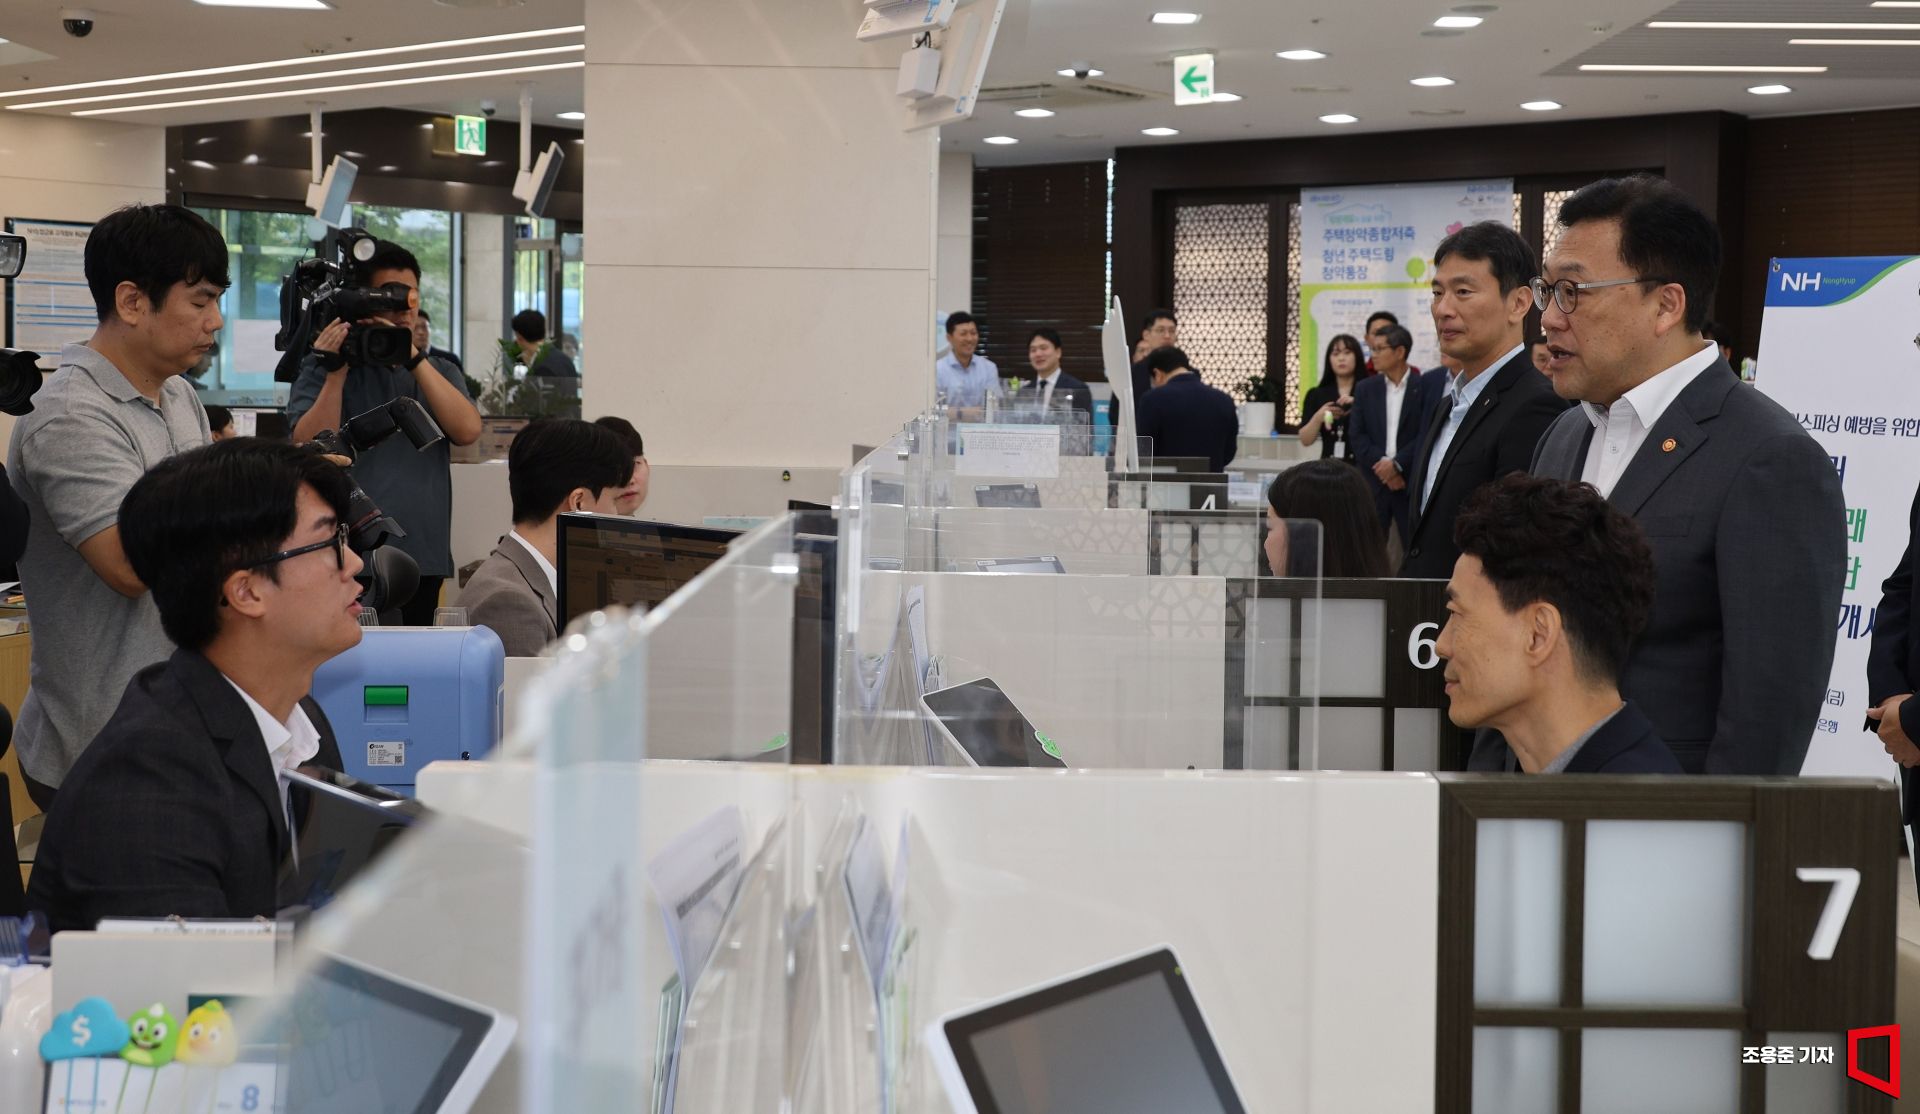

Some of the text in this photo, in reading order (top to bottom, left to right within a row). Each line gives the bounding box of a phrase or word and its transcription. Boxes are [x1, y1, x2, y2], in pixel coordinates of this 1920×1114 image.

[1323, 226, 1416, 242] 주택청약종합저축
[1323, 246, 1394, 264] 청년 주택드림
[1323, 265, 1368, 281] 청약통장
[1781, 272, 1821, 291] NH
[1844, 415, 1887, 436] 예방을
[1408, 621, 1441, 670] 6
[1826, 688, 1845, 707] (금)
[1796, 867, 1861, 960] 7
[71, 1014, 92, 1047] $
[241, 1084, 260, 1112] 8
